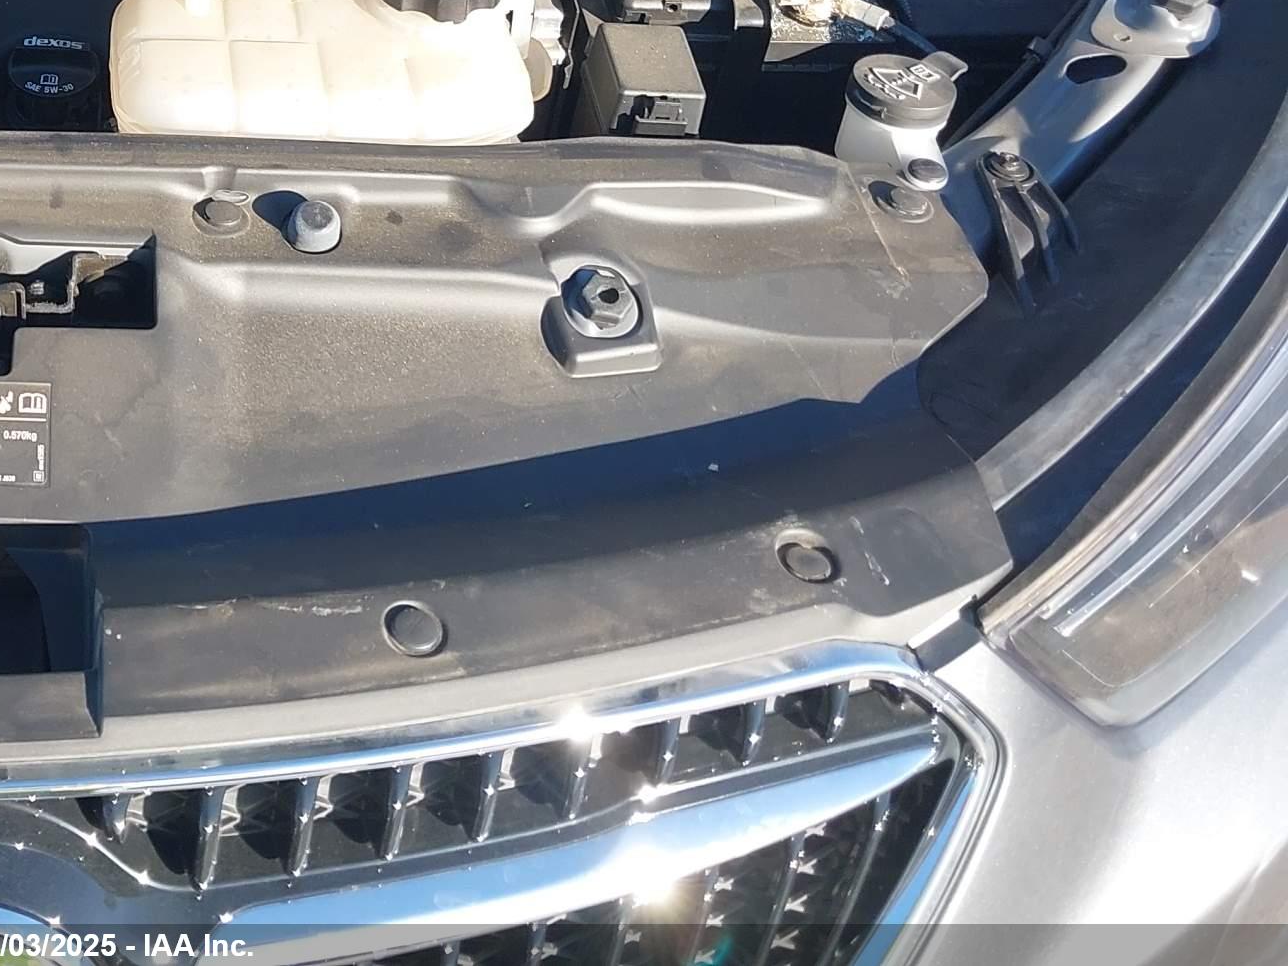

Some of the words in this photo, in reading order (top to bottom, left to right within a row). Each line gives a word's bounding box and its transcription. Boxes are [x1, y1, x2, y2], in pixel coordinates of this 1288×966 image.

[23, 36, 86, 50] dexos
[24, 81, 42, 92] SAE
[43, 83, 74, 94] 5W-30
[3, 430, 38, 443] 0.570kg
